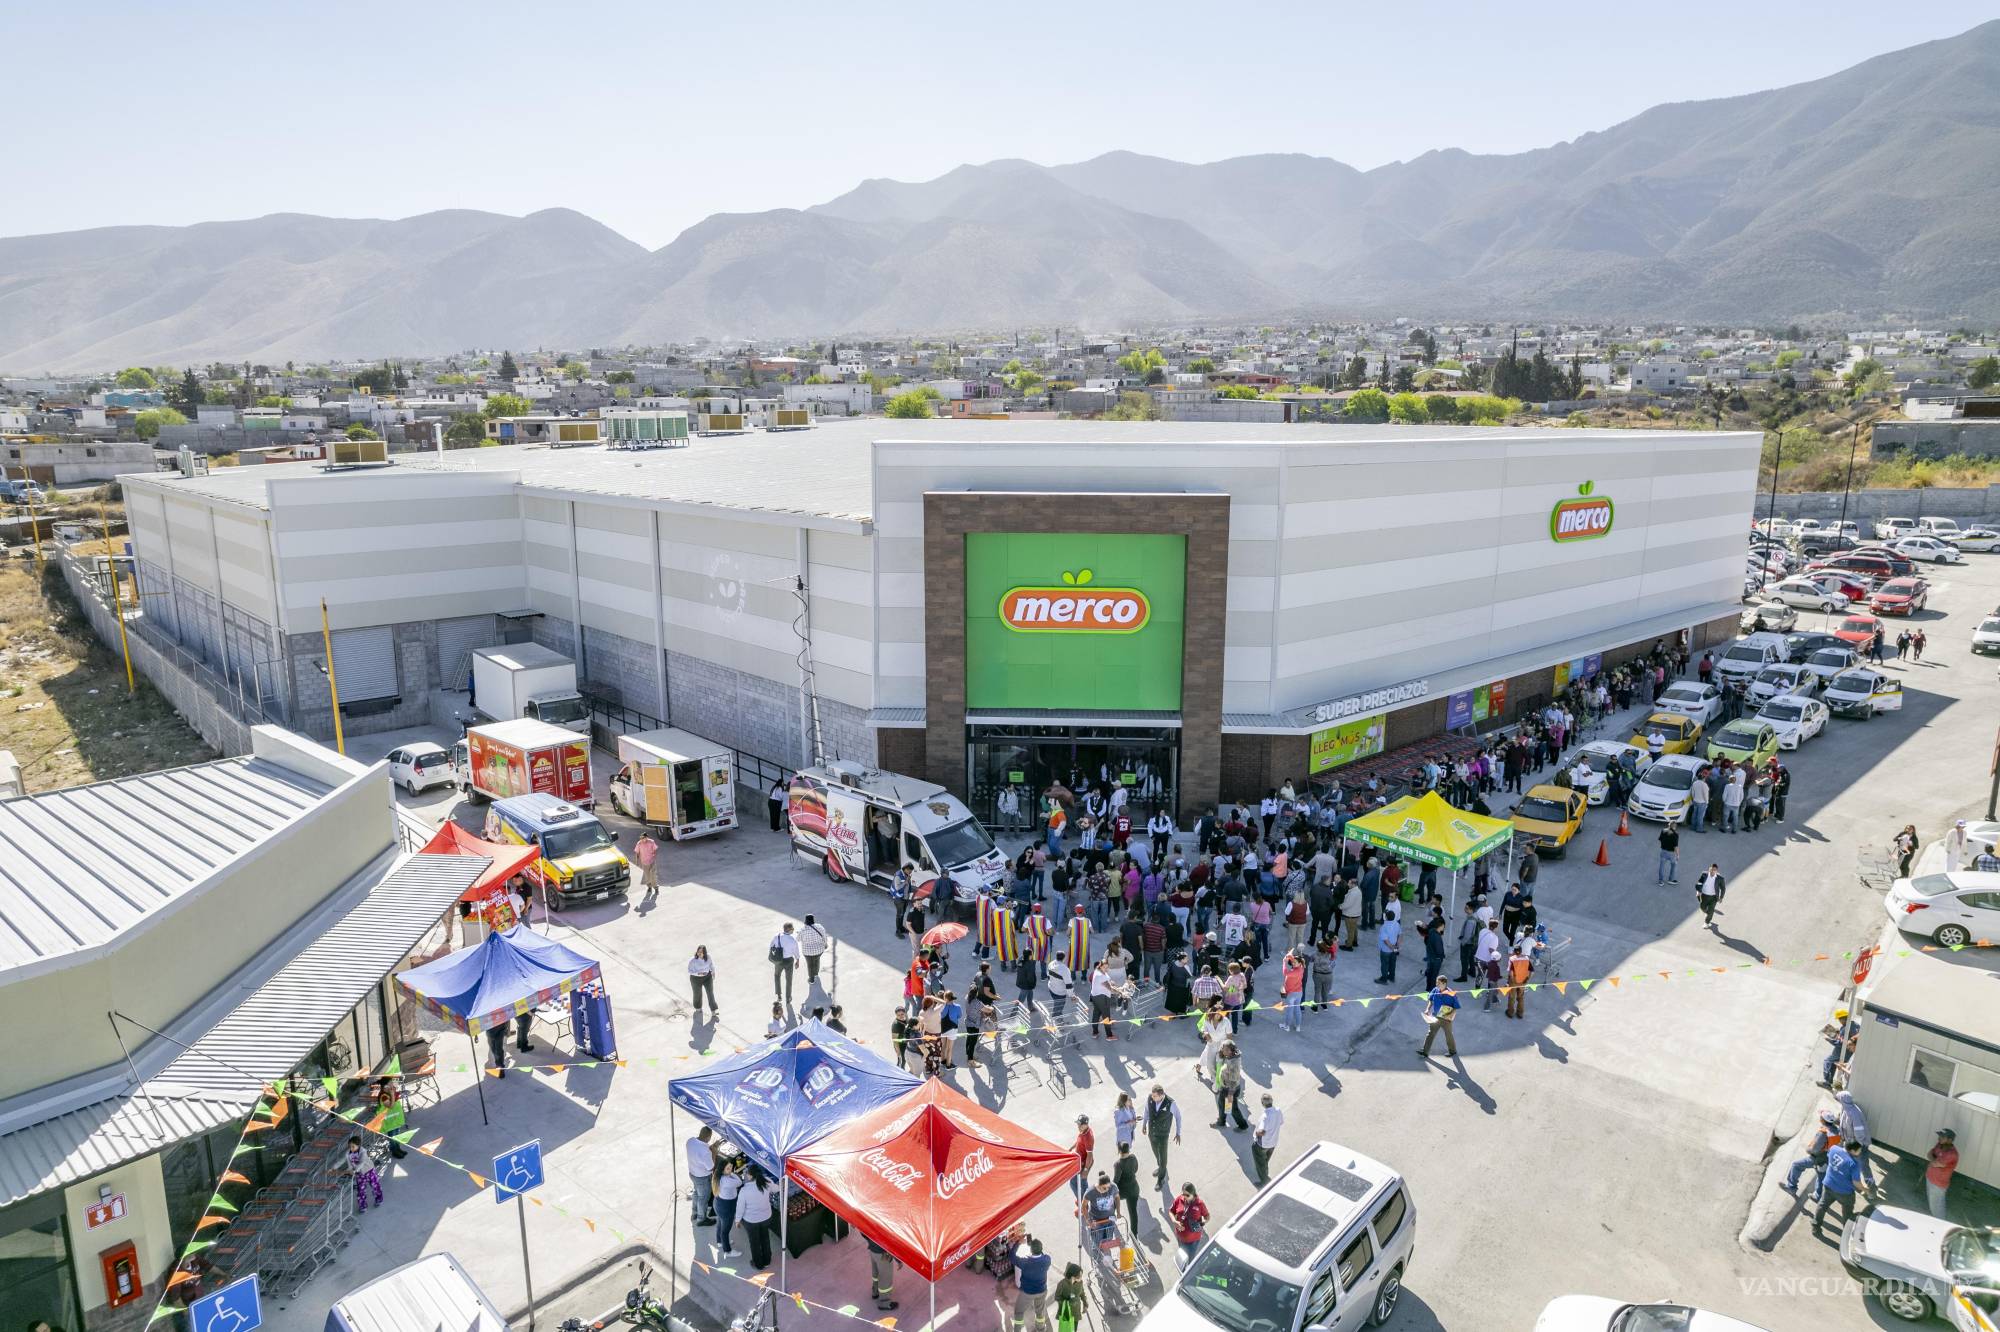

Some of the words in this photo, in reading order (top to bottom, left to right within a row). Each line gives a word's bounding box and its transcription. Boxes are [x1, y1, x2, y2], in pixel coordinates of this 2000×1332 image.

[1560, 506, 1609, 532] merco
[1012, 597, 1138, 623] merco
[1315, 698, 1360, 722] SUPER
[1361, 680, 1428, 710] PRECIAZOS
[1362, 833, 1370, 842] El
[1388, 840, 1398, 850] de
[1398, 845, 1413, 856] esta
[1415, 850, 1437, 862] Tierra
[1230, 928, 1237, 939] 2
[1854, 957, 1871, 977] ALTO
[743, 1068, 783, 1087] FUD
[803, 1066, 834, 1101] FUD
[859, 1148, 925, 1192] Coca-Cola
[936, 1147, 995, 1200] Coca-Cola
[943, 1242, 972, 1270] Coca-Cola
